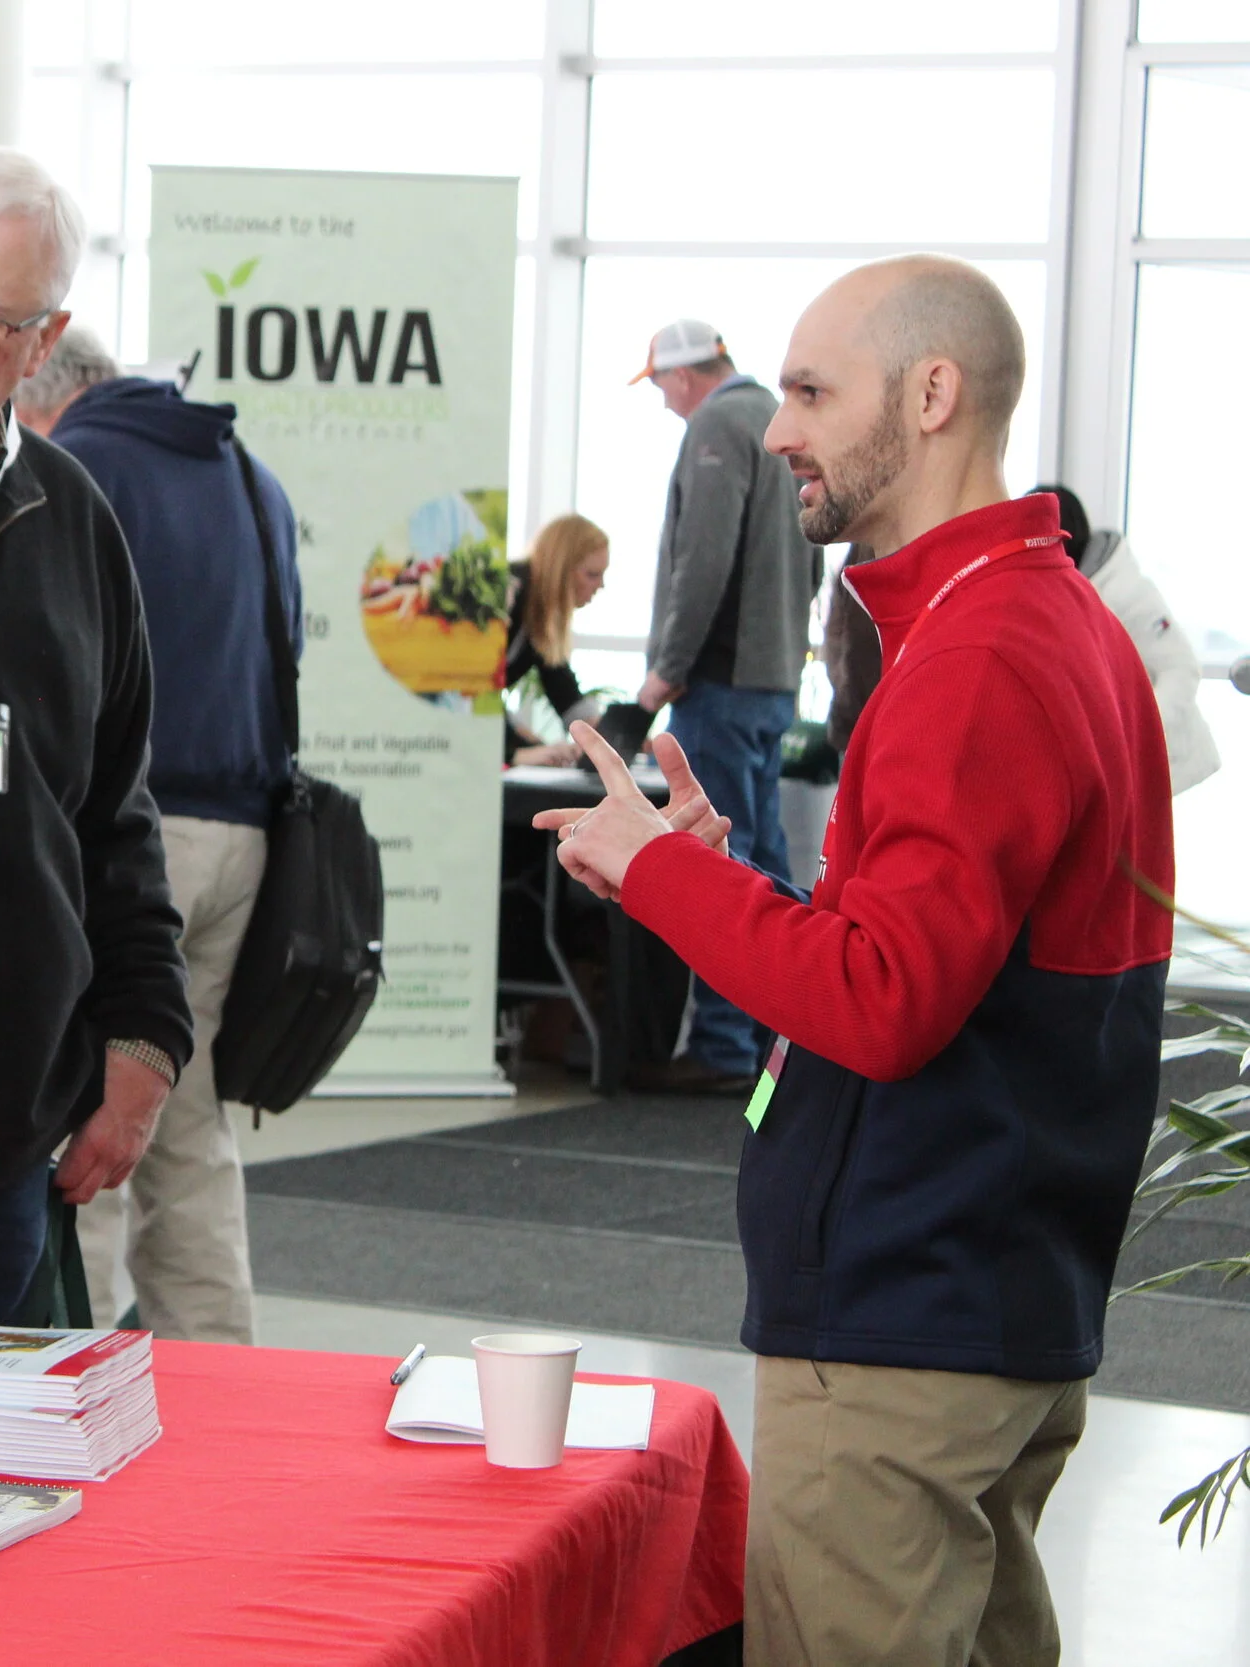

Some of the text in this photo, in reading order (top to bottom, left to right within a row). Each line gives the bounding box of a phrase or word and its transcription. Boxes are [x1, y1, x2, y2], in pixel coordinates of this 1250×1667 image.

[174, 210, 356, 239] Welcome to the
[216, 303, 443, 386] IOWA
[928, 554, 989, 610] GRINNELL COLLEGE
